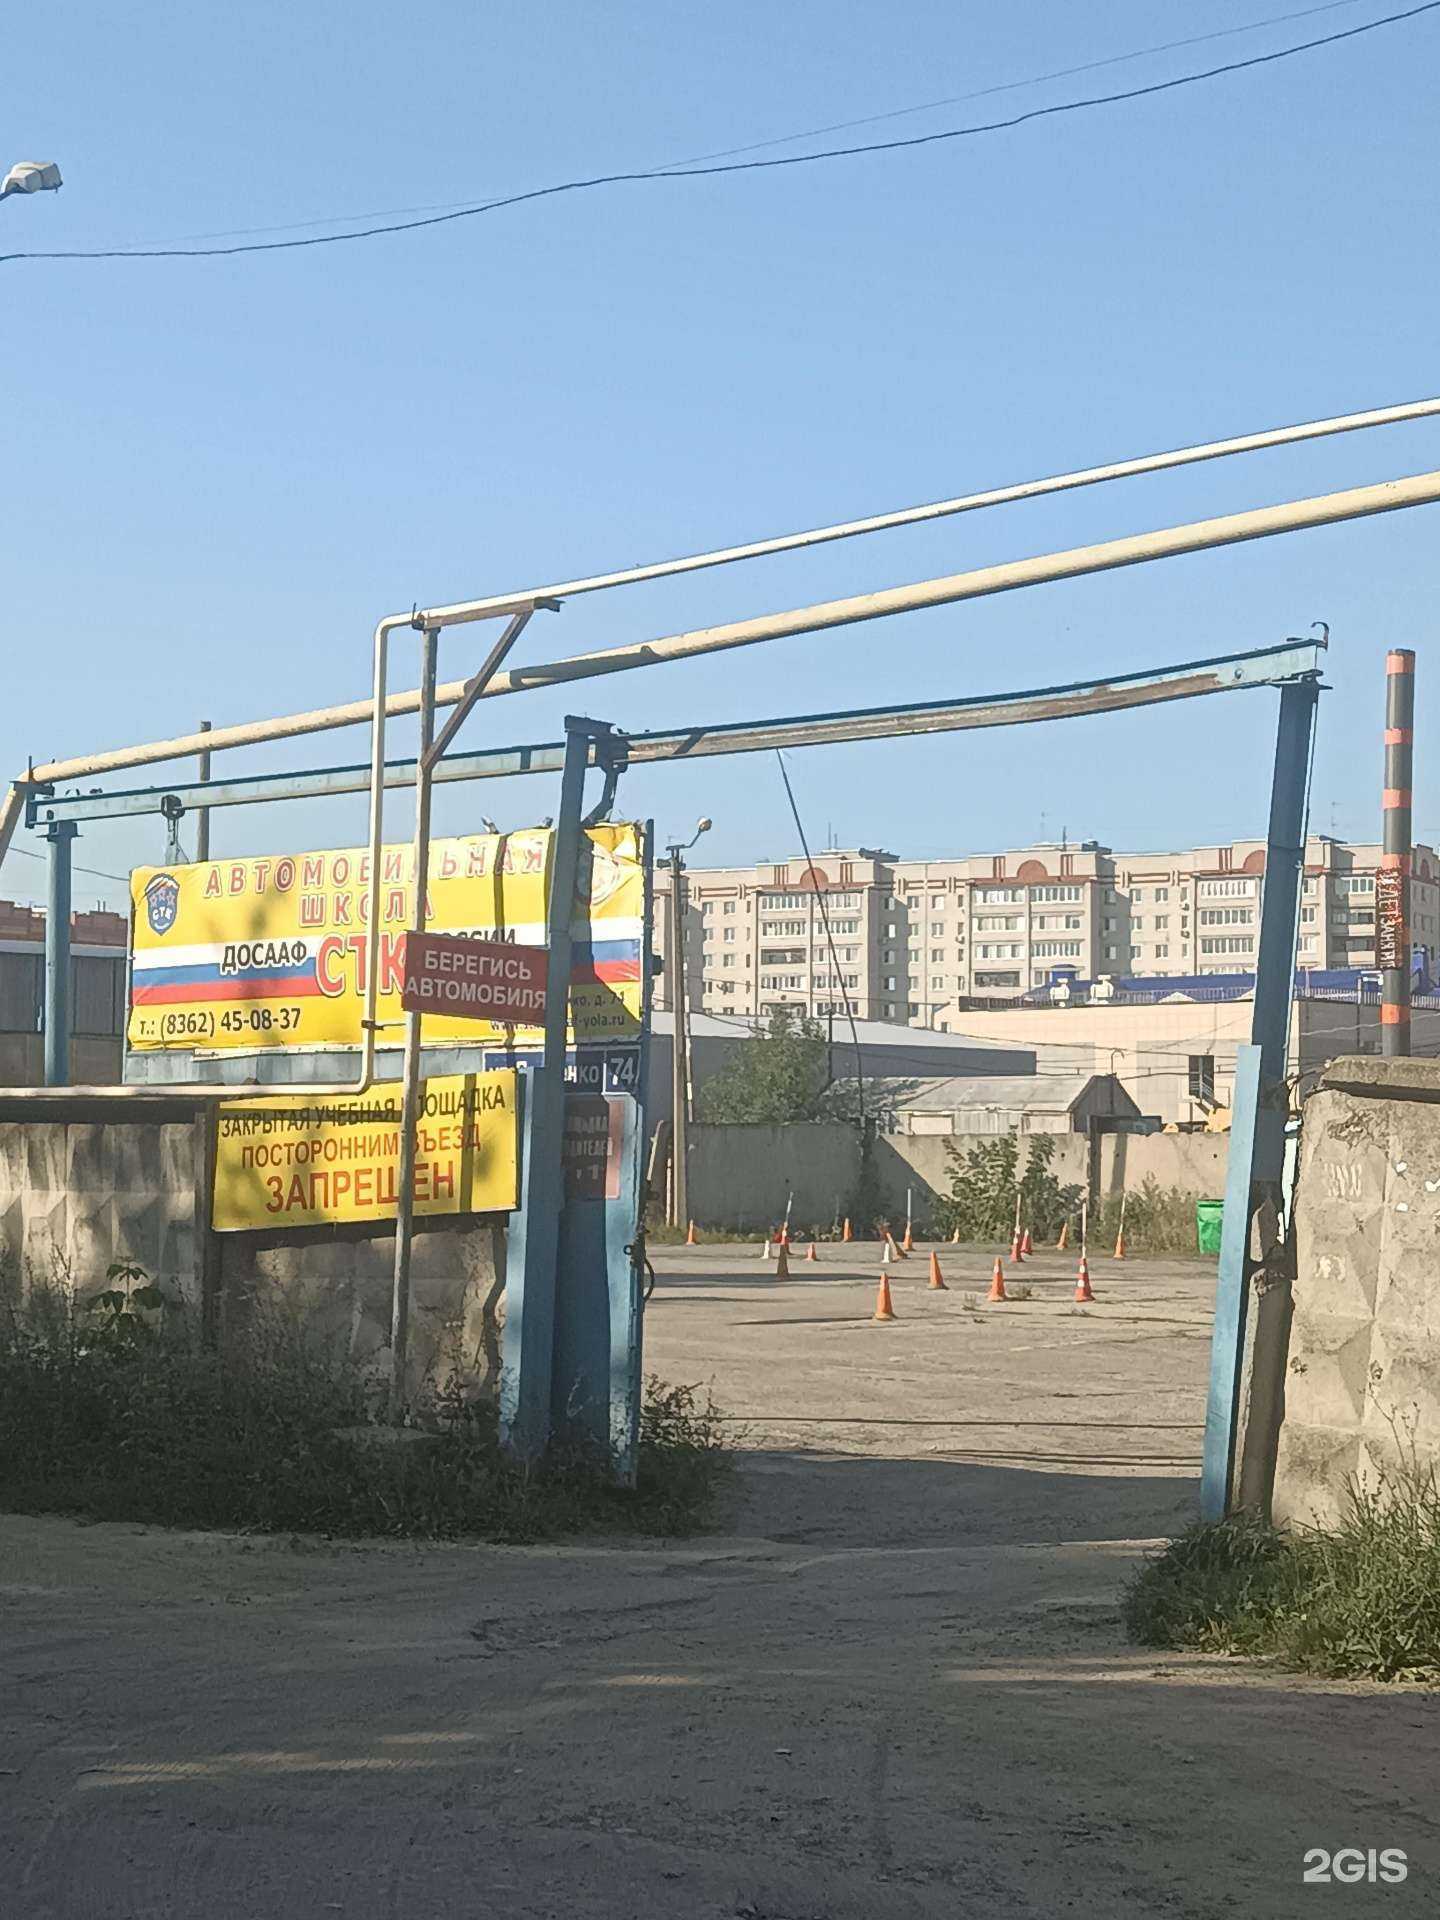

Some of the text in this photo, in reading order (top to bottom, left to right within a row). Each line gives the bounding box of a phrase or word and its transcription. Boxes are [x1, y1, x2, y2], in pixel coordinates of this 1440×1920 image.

[205, 843, 544, 897] АВТОМОБИЬНАЯ
[221, 940, 307, 973] ДОСААФ
[424, 950, 533, 981] БЕРЕГИСЬ
[405, 976, 547, 1009] АВТОМОБИЛЯ
[160, 1011, 215, 1038] (8362)
[220, 1007, 302, 1032] 45-08-37
[610, 1057, 634, 1085] 74
[221, 1084, 506, 1138] ЗАКРЫТАЯ УЧЕБНАЯ ЛОЩАДКА
[241, 1132, 399, 1169] ПОСТОРОННИМ
[265, 1160, 455, 1213] ЗАПРЕЩЕН
